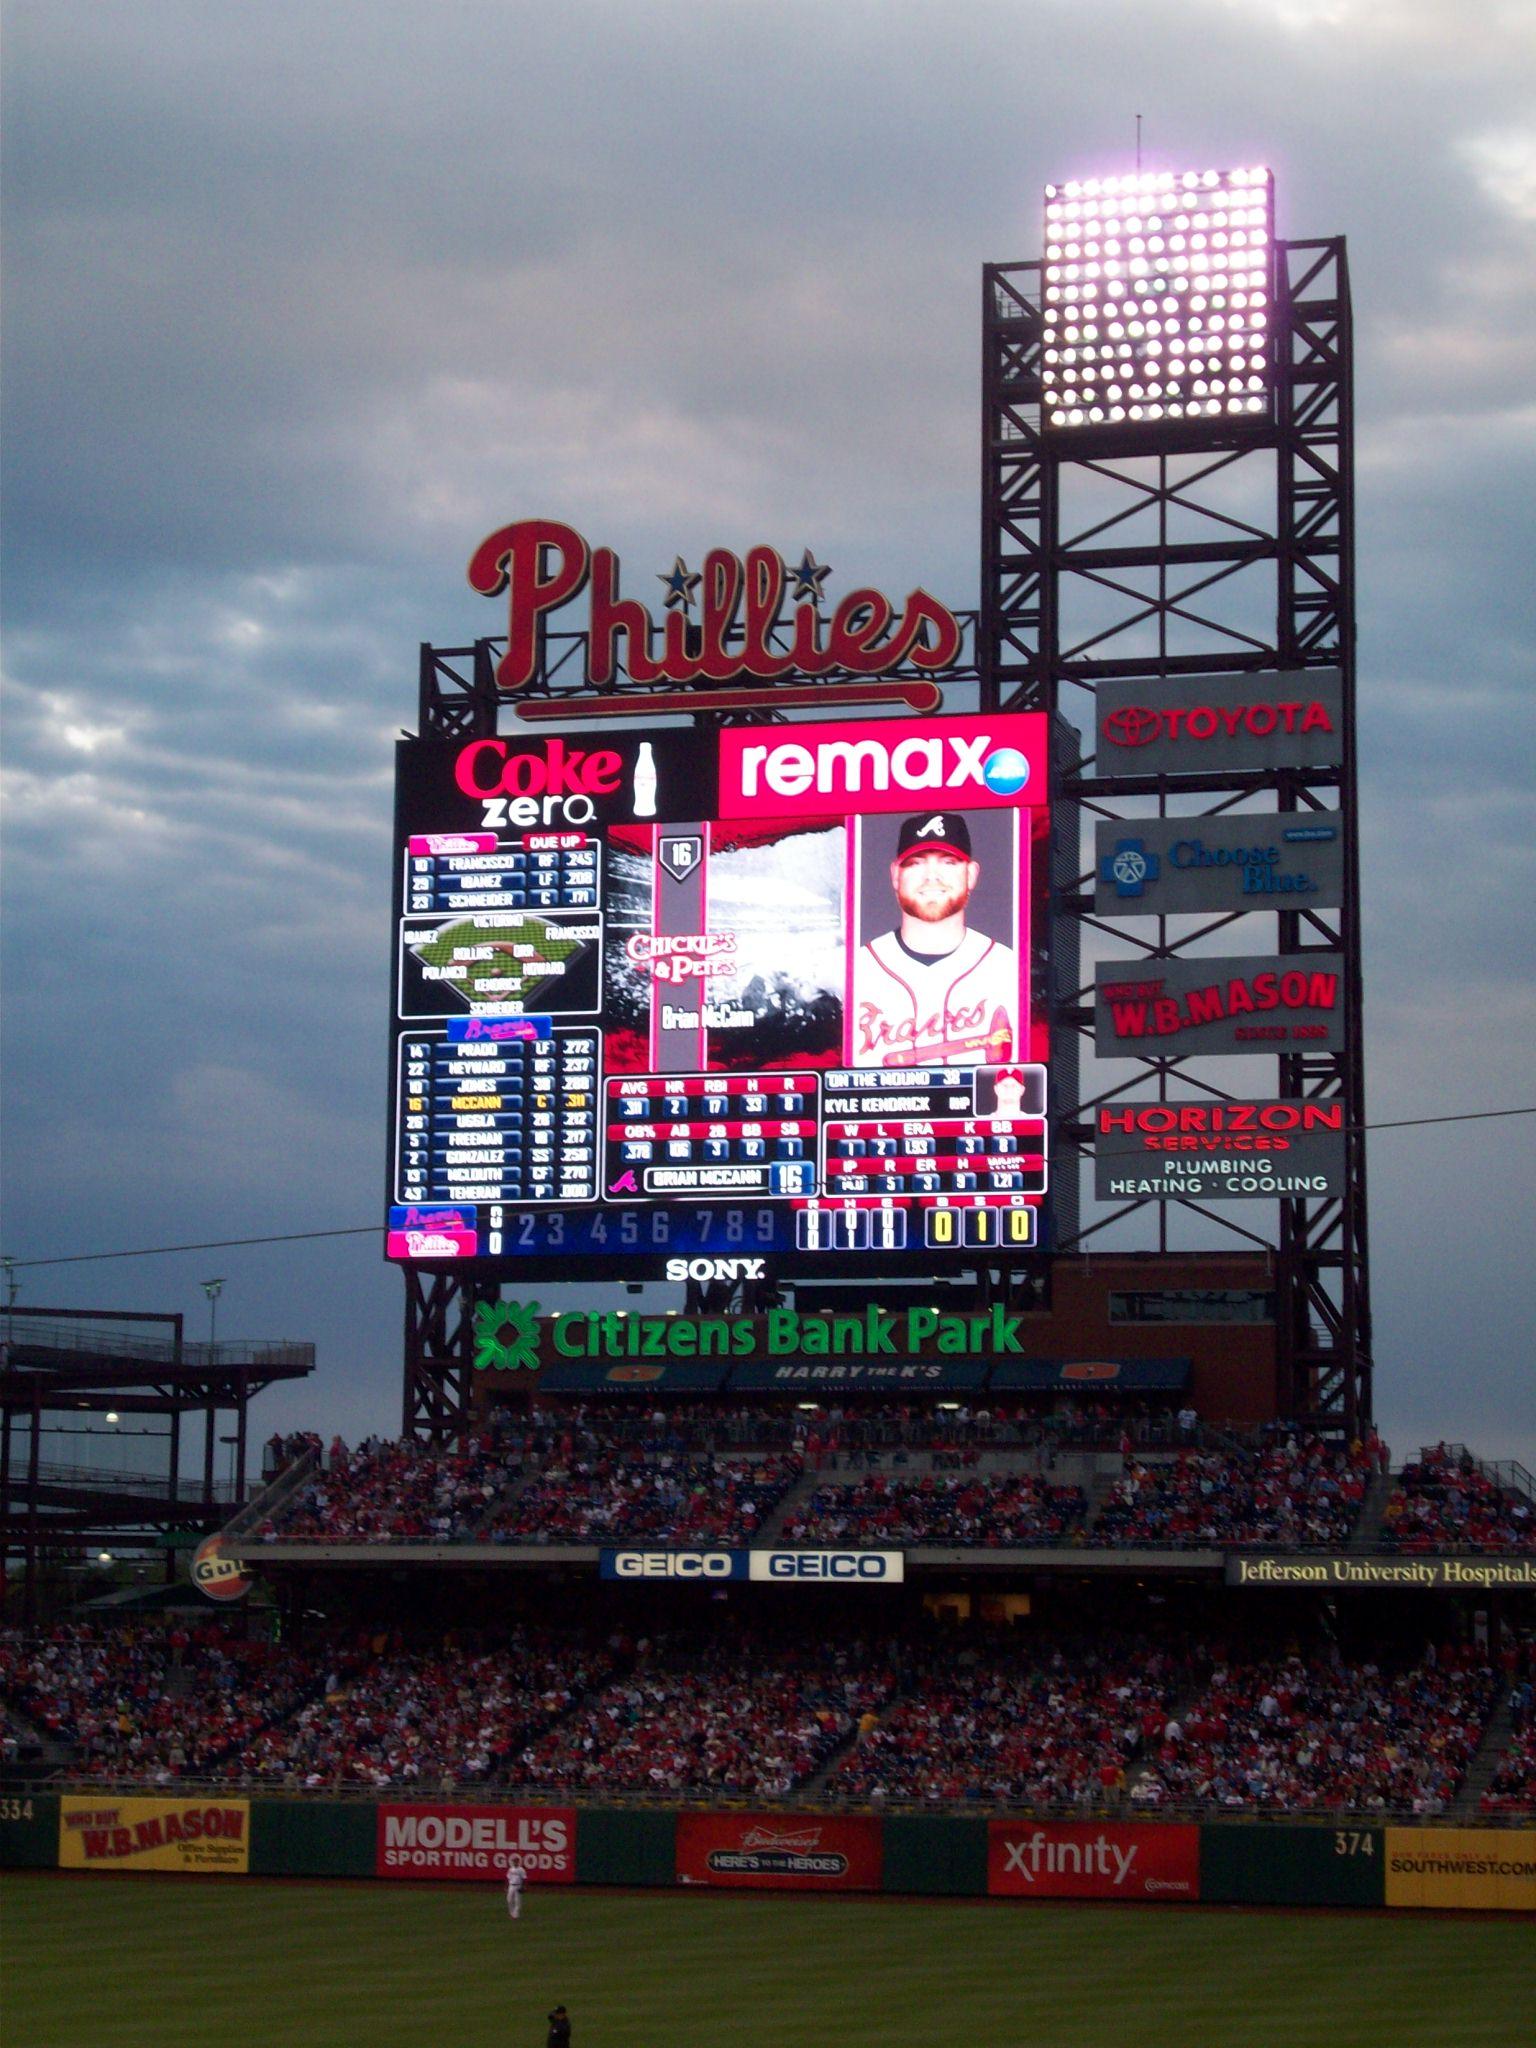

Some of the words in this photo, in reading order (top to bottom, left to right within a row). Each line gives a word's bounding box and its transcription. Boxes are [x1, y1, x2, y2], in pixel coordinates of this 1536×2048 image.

[467, 518, 963, 690] Phillies
[1161, 701, 1333, 740] TOYOTA
[455, 739, 623, 799] Coke
[741, 736, 992, 797] remax
[481, 794, 594, 827] zero
[530, 837, 558, 848] DUE
[563, 836, 580, 847] UP
[672, 843, 691, 866] 16
[1168, 840, 1280, 869] Choose
[449, 856, 514, 871] FRANCISCO
[461, 876, 502, 888] IBANEZ
[539, 874, 553, 885] LF
[449, 894, 513, 907] SCHNEIDER
[541, 893, 550, 904] C
[546, 927, 600, 940] FRANCISCO
[453, 948, 493, 960] ROLLINS
[523, 962, 565, 975] HOWARD
[662, 1006, 699, 1029] Brian
[702, 1004, 754, 1028] McCann
[457, 1045, 497, 1056] PRADO
[536, 1042, 551, 1054] LF
[449, 1062, 506, 1075] HEYWARD
[535, 1060, 551, 1072] RF
[457, 1080, 496, 1093] JONES
[621, 1081, 647, 1095] AVG
[665, 1081, 684, 1093] HR
[704, 1080, 727, 1092] RBI
[748, 1079, 757, 1091] H
[784, 1078, 794, 1090] R
[829, 1075, 850, 1087] ON
[853, 1074, 877, 1087] THE
[880, 1072, 930, 1086] MOUND
[409, 1099, 421, 1111] 16
[452, 1096, 502, 1110] MCCANN
[537, 1095, 547, 1108] C
[671, 1102, 679, 1114] 2
[825, 1099, 859, 1113] KYLE
[862, 1097, 930, 1112] KENDRICK
[1100, 1104, 1342, 1133] HORIZON
[625, 1125, 656, 1138] OB%
[670, 1124, 689, 1137] AB
[709, 1124, 727, 1137] 2B
[742, 1124, 761, 1136] BB
[781, 1122, 799, 1135] SB
[844, 1124, 859, 1136] W
[878, 1124, 887, 1136] L
[904, 1122, 934, 1135] ERA
[965, 1121, 976, 1134] K
[991, 1121, 1012, 1133] BB
[449, 1133, 502, 1146] FREEMAN
[877, 1142, 885, 1155] 2
[966, 1139, 974, 1153] 3
[1144, 1135, 1290, 1152] SERVICES
[410, 1153, 419, 1164] 2
[446, 1150, 505, 1163] GONZALEZ
[532, 1150, 549, 1162] SS
[712, 1144, 720, 1156] 3
[843, 1160, 857, 1172] IP
[885, 1160, 896, 1172] R
[916, 1159, 936, 1171] ER
[958, 1159, 968, 1169] H
[1164, 1159, 1272, 1175] PLUMBING
[654, 1171, 697, 1186] BRIAN
[701, 1170, 761, 1185] MCCANN
[780, 1166, 802, 1193] 16
[887, 1177, 895, 1190] 5
[924, 1176, 932, 1190] 3
[1110, 1177, 1202, 1194] HEATING
[1226, 1176, 1328, 1192] COOLING
[535, 1185, 545, 1198] P
[519, 1214, 535, 1245] 2
[547, 1214, 564, 1244] 3
[591, 1213, 608, 1244] 4
[621, 1212, 637, 1243] 5
[652, 1211, 669, 1243] 6
[697, 1211, 712, 1241] 7
[727, 1210, 743, 1241] 8
[757, 1210, 774, 1241] 9
[935, 1211, 952, 1241] 0
[978, 1211, 986, 1241] 1
[1011, 1210, 1028, 1240] 0
[553, 1310, 755, 1359] Citizens
[767, 1304, 898, 1357] Bank
[907, 1303, 1024, 1355] Park
[775, 1366, 862, 1379] HARRY
[868, 1367, 896, 1376] THE
[900, 1365, 942, 1378] K'S
[615, 1553, 732, 1577] GEICO
[769, 1554, 886, 1578] GEICO
[1240, 1559, 1328, 1584] Jefferson
[1333, 1560, 1438, 1588] University
[1444, 1562, 1536, 1588] Hospitals
[385, 1816, 567, 1852] MODELL'S
[1335, 1832, 1374, 1856] 374
[384, 1850, 489, 1868] SPORTING
[493, 1853, 567, 1871] GOODS
[714, 1856, 759, 1869] HERE'S
[788, 1857, 840, 1871] HEROES
[1004, 1832, 1138, 1884] xfinity
[1391, 1859, 1536, 1876] SOUTHWEST.COM
